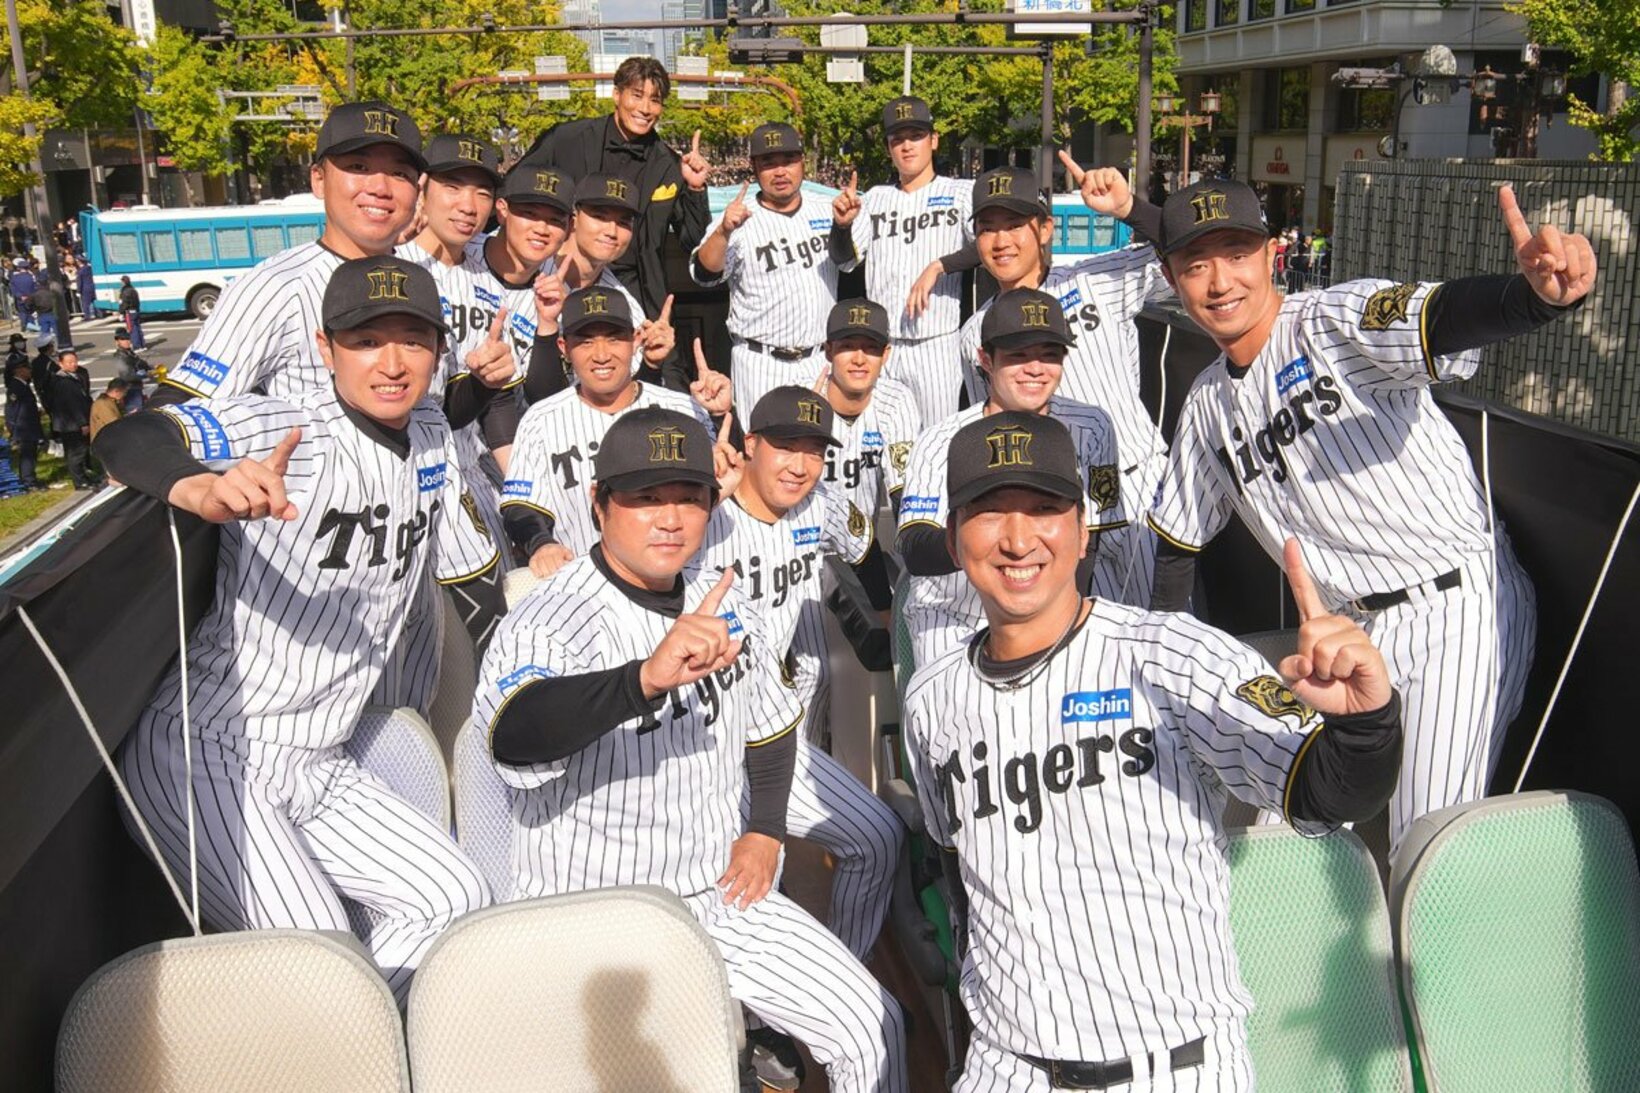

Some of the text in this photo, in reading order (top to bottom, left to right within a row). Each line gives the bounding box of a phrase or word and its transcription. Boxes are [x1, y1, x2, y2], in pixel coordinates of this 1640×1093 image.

[870, 207, 960, 245] Tigers
[1063, 696, 1130, 718] Joshin
[935, 727, 1156, 836] Tigers
